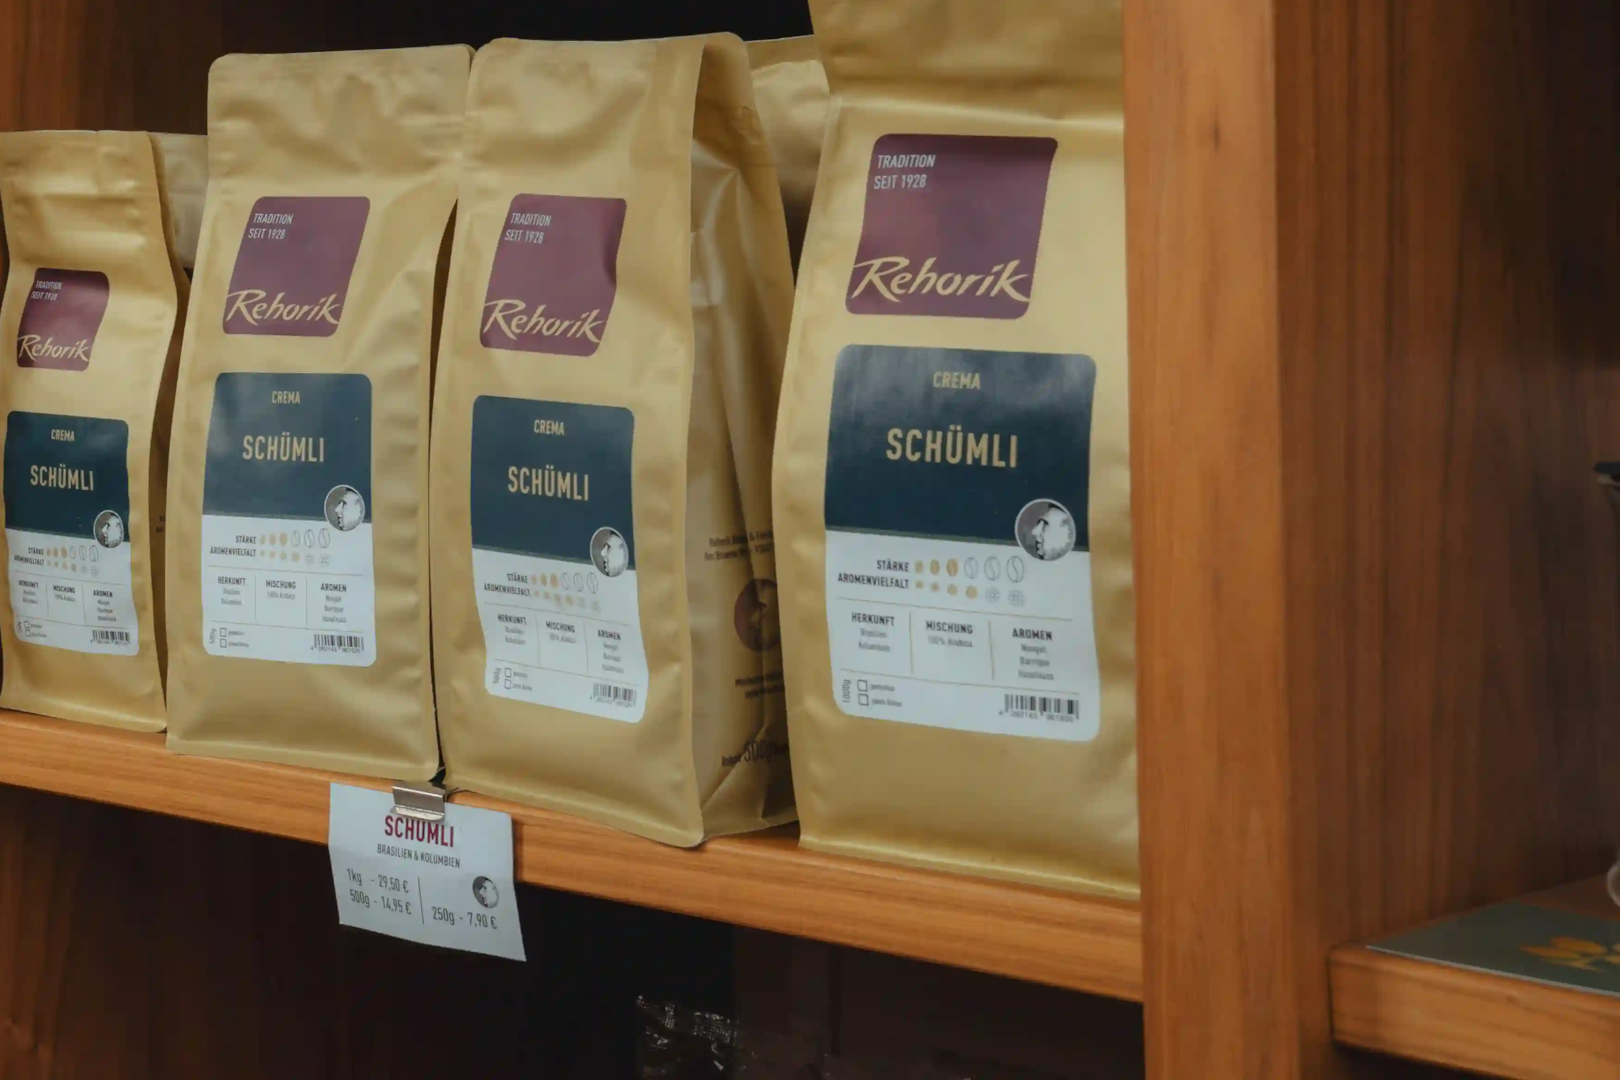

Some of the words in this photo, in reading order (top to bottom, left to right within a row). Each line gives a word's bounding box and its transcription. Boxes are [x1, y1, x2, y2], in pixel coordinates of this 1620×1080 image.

[878, 154, 936, 169] TRADITION
[874, 175, 897, 190] SEIT
[901, 174, 927, 188] 1928
[253, 212, 293, 225] TRADITION
[511, 212, 552, 227] TRADITION
[248, 227, 266, 239] SEIT
[267, 228, 286, 240] 1928
[505, 229, 523, 241] SEIT
[525, 230, 544, 244] 1928
[36, 281, 62, 290] TRADITION
[851, 256, 1030, 303] Rehorik
[227, 289, 342, 327] Rehorik
[483, 299, 604, 344] Rehorik
[17, 335, 89, 362] Rehorik
[933, 371, 981, 390] CREMA
[272, 391, 300, 404] CREMA
[534, 419, 565, 436] CREMA
[51, 429, 75, 442] CREMA
[242, 431, 324, 462] SCHÜMLI
[886, 425, 1018, 468] SCHÜMLI
[30, 464, 94, 491] SCHÜMLI
[508, 464, 589, 501] SCHÜMLI
[235, 535, 256, 544] STÄRKE
[210, 547, 256, 557] AROMENVIELFALT
[877, 560, 909, 572] STÄRKE
[217, 576, 246, 586] HERKUNFT
[266, 579, 296, 590] MISCHUNG
[507, 573, 529, 584] STÄRKE
[838, 573, 910, 589] AROMENVIELFALT
[93, 590, 113, 598] AROMEN
[321, 583, 347, 592] AROMEN
[484, 583, 531, 597] AROMENVIELFALT
[497, 614, 527, 625] HERKUNFT
[546, 621, 575, 633] MISCHUNG
[851, 612, 895, 627] HERKUNFT
[598, 629, 621, 641] AROMEN
[926, 620, 973, 635] MISCHUNG
[1012, 627, 1052, 641] AROMEN
[377, 844, 412, 860] BRASILIEN
[414, 852, 419, 861] &
[420, 852, 461, 869] KOLUMBIEN
[347, 868, 362, 886] 1kg
[378, 875, 401, 892] 29,50
[402, 880, 409, 894] €
[350, 890, 370, 908] 500g
[381, 896, 403, 913] 14,95
[405, 901, 412, 915] €
[432, 907, 455, 926] 250g
[468, 912, 488, 928] 7,90
[490, 916, 498, 930] €
